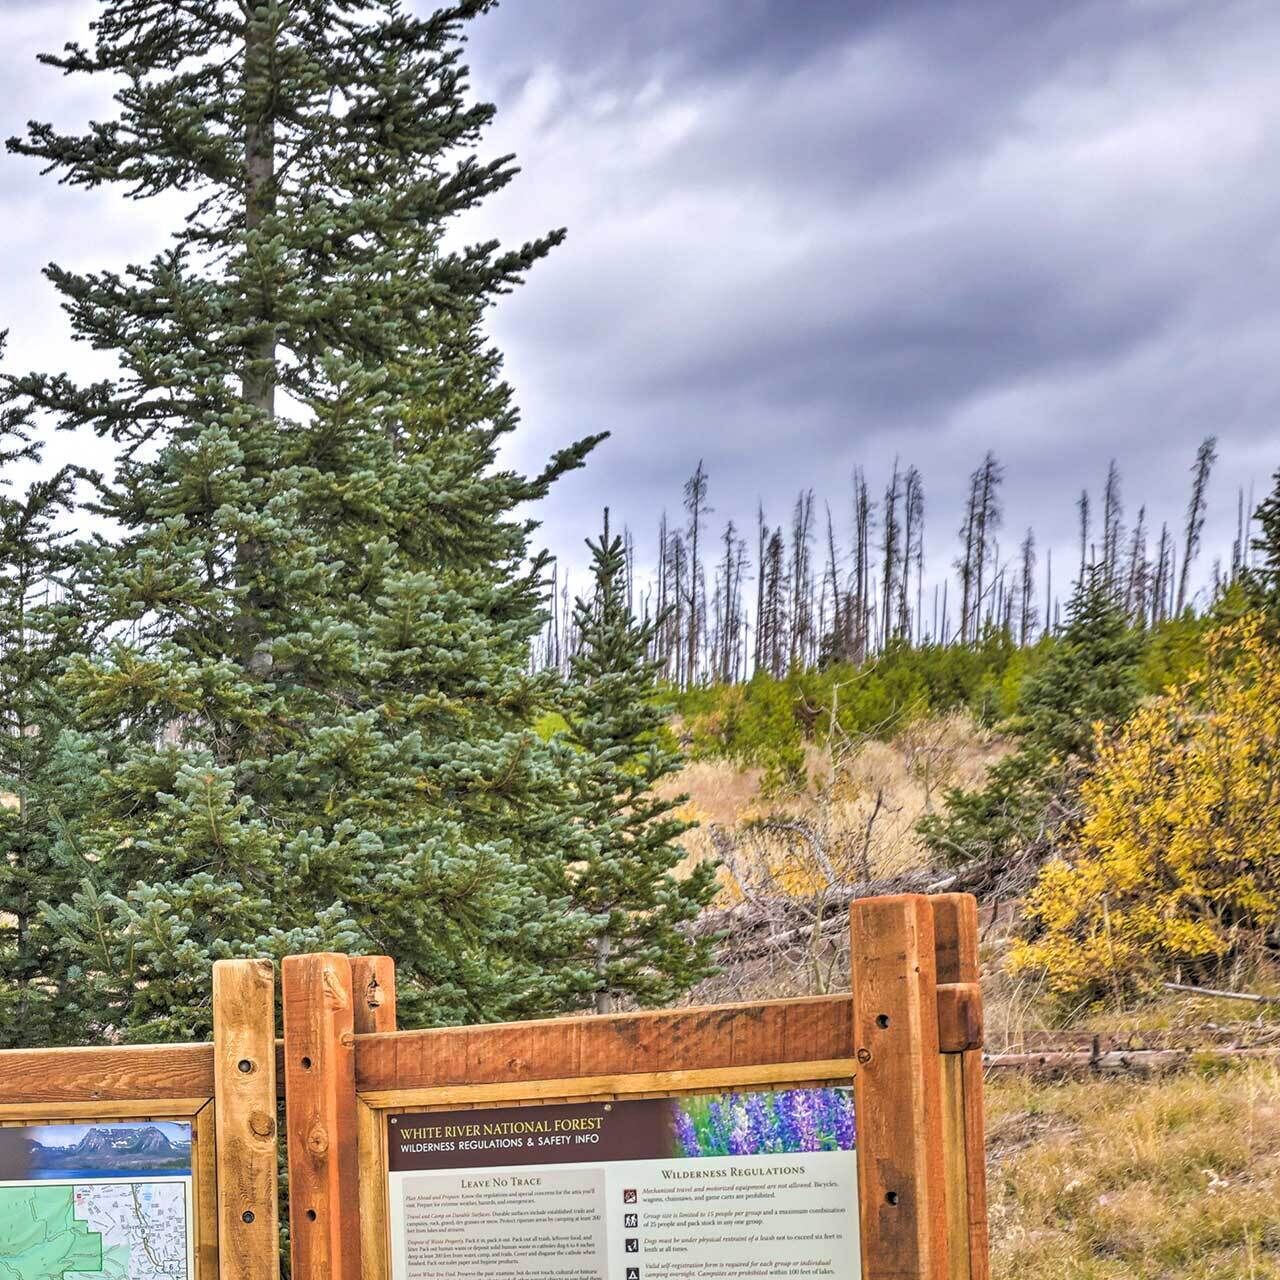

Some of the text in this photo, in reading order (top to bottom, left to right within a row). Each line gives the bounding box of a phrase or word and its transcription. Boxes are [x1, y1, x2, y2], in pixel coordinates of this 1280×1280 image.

[400, 1116, 603, 1140] WHITE RIVER NATIONAL FOREST
[400, 1133, 599, 1153] WILDERNESS REGULATIONS & SAFETY INFO
[661, 1163, 806, 1180] WILDERNESS REGULATIONS
[461, 1176, 541, 1188] LEAVE NO TRACE
